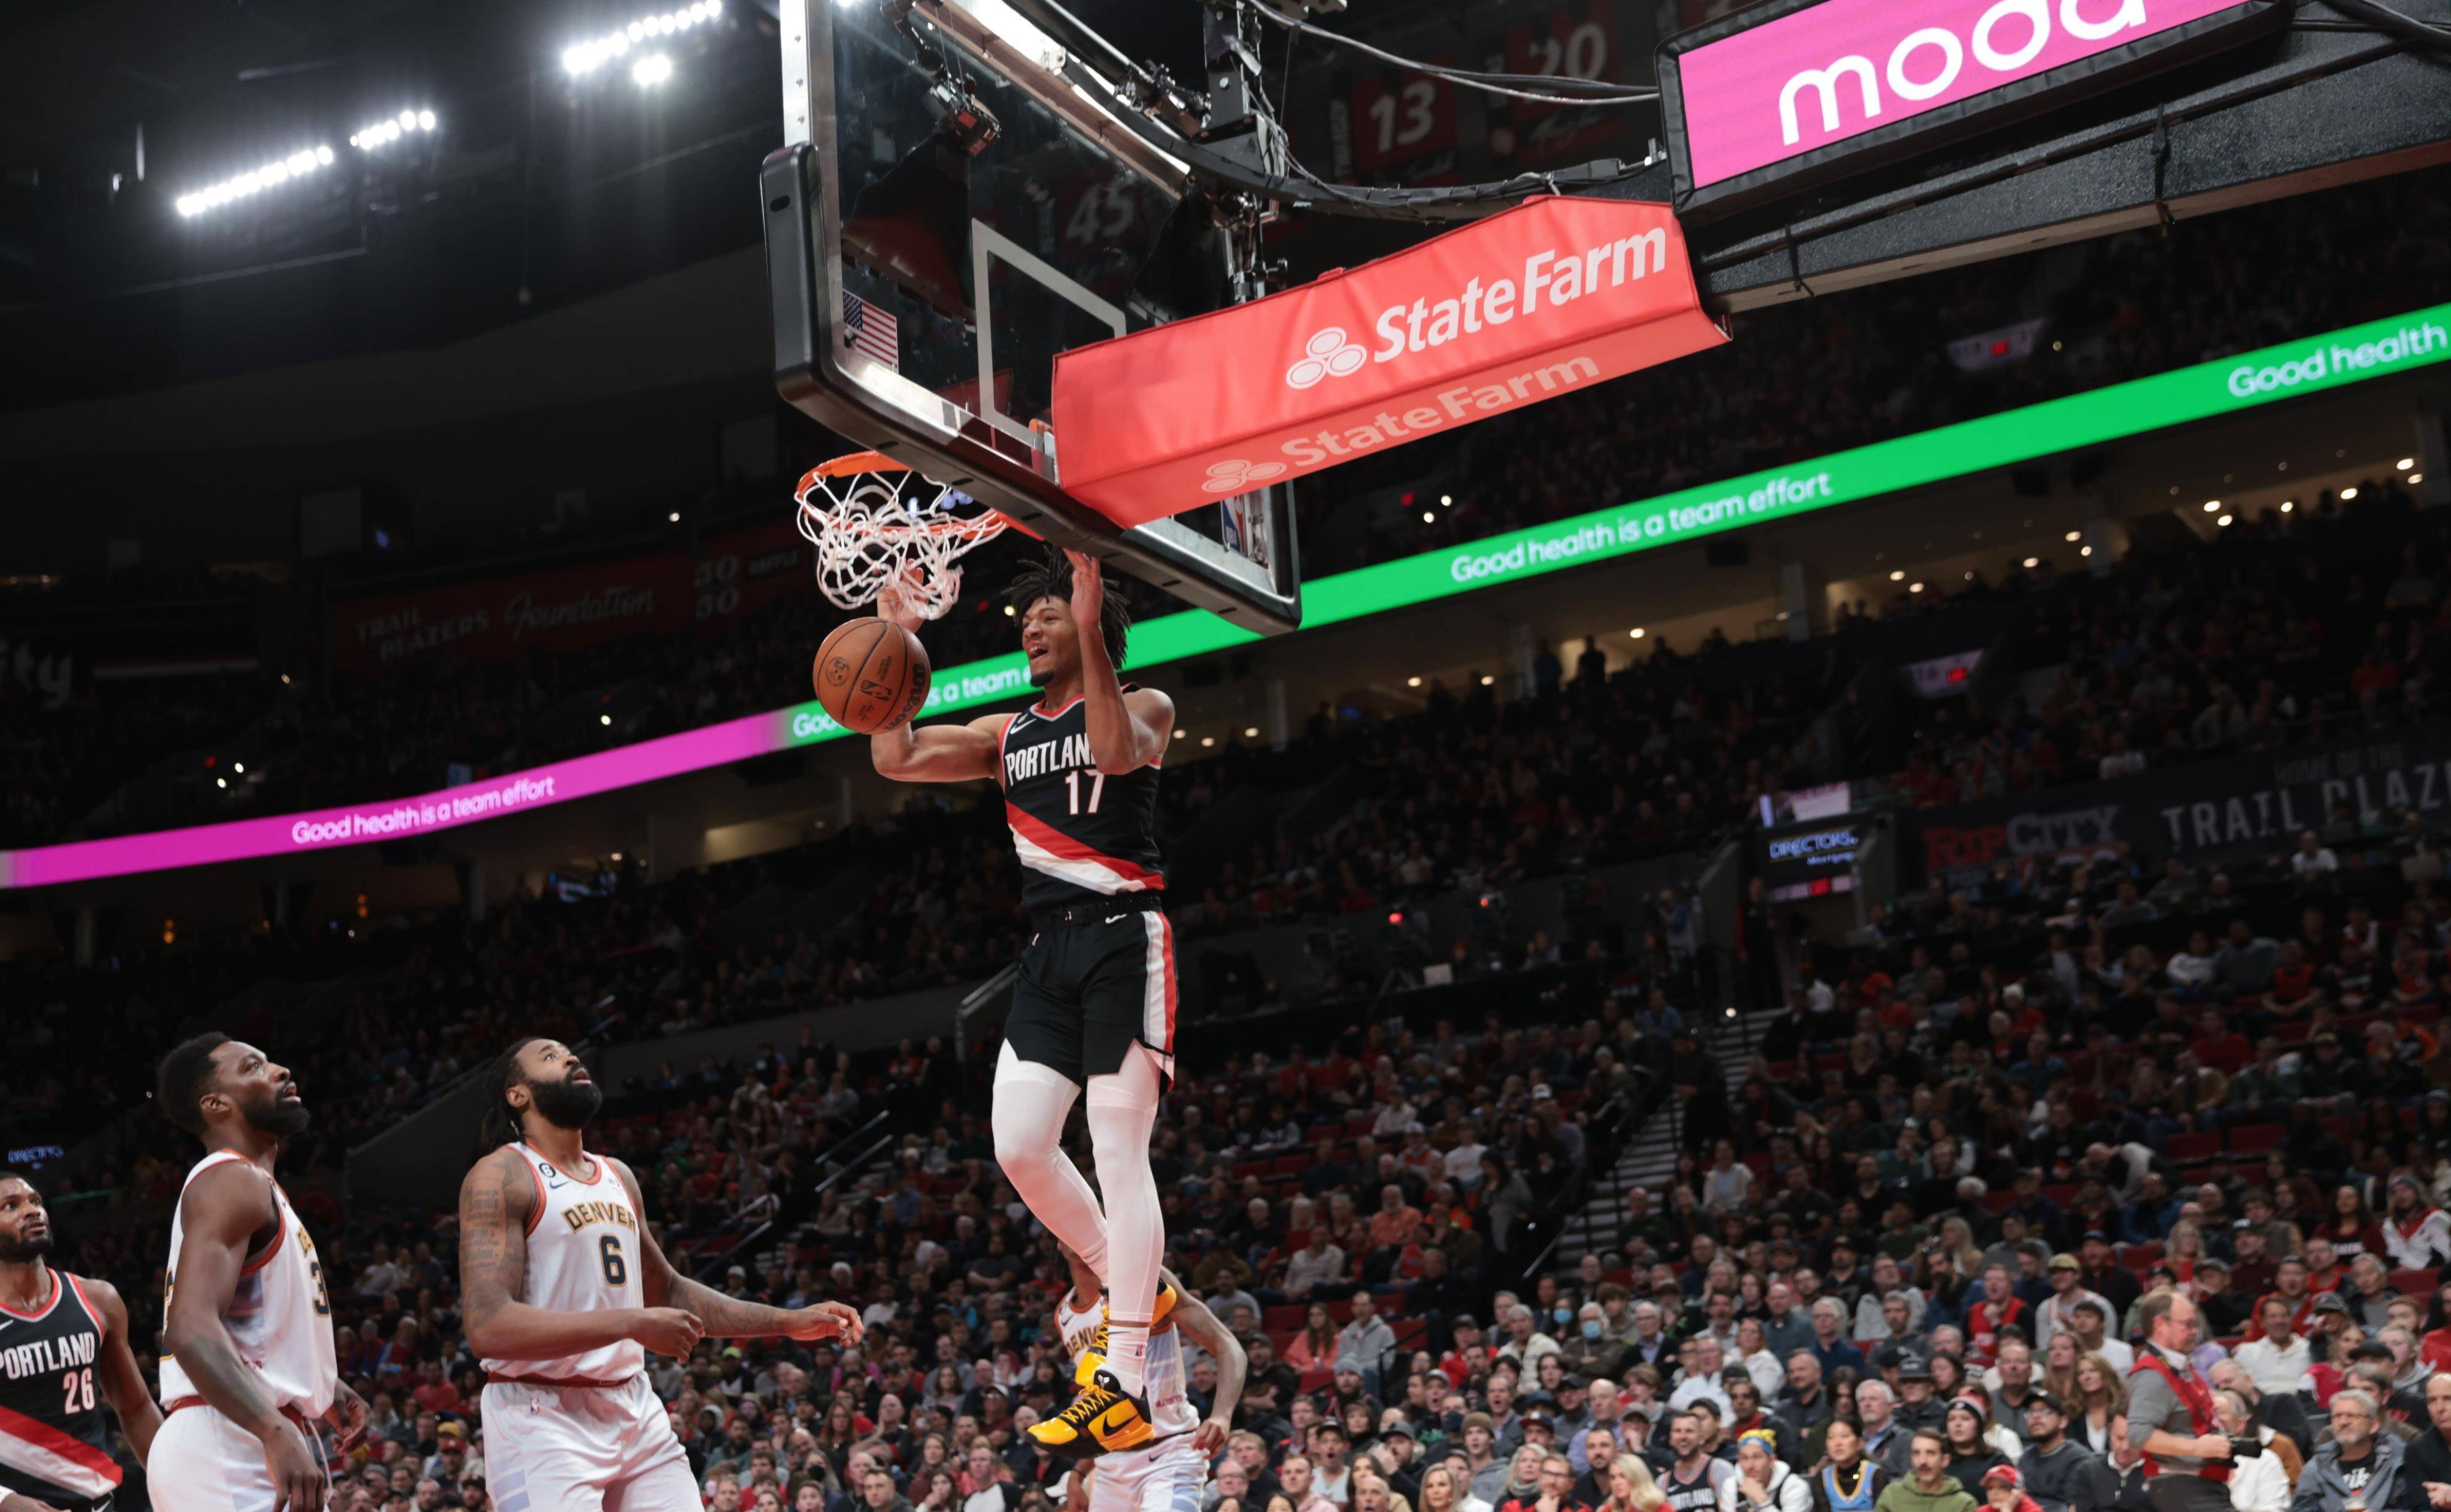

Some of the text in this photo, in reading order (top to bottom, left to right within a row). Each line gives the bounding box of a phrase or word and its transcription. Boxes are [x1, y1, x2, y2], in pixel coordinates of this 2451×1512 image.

[1368, 80, 1437, 154] 13
[1065, 183, 1136, 245] 45
[2227, 321, 2448, 397] Good health
[1451, 472, 1834, 582] Good health is a team effort
[793, 711, 836, 738] Goo
[943, 685, 960, 703] a
[962, 666, 1021, 699] team
[1005, 732, 1096, 787] PORTLAN
[292, 776, 556, 844] Good health is a team effort
[1064, 768, 1106, 815] 17
[561, 1200, 637, 1235] DENVER
[598, 1232, 628, 1288] 6
[62, 1366, 96, 1416] 26
